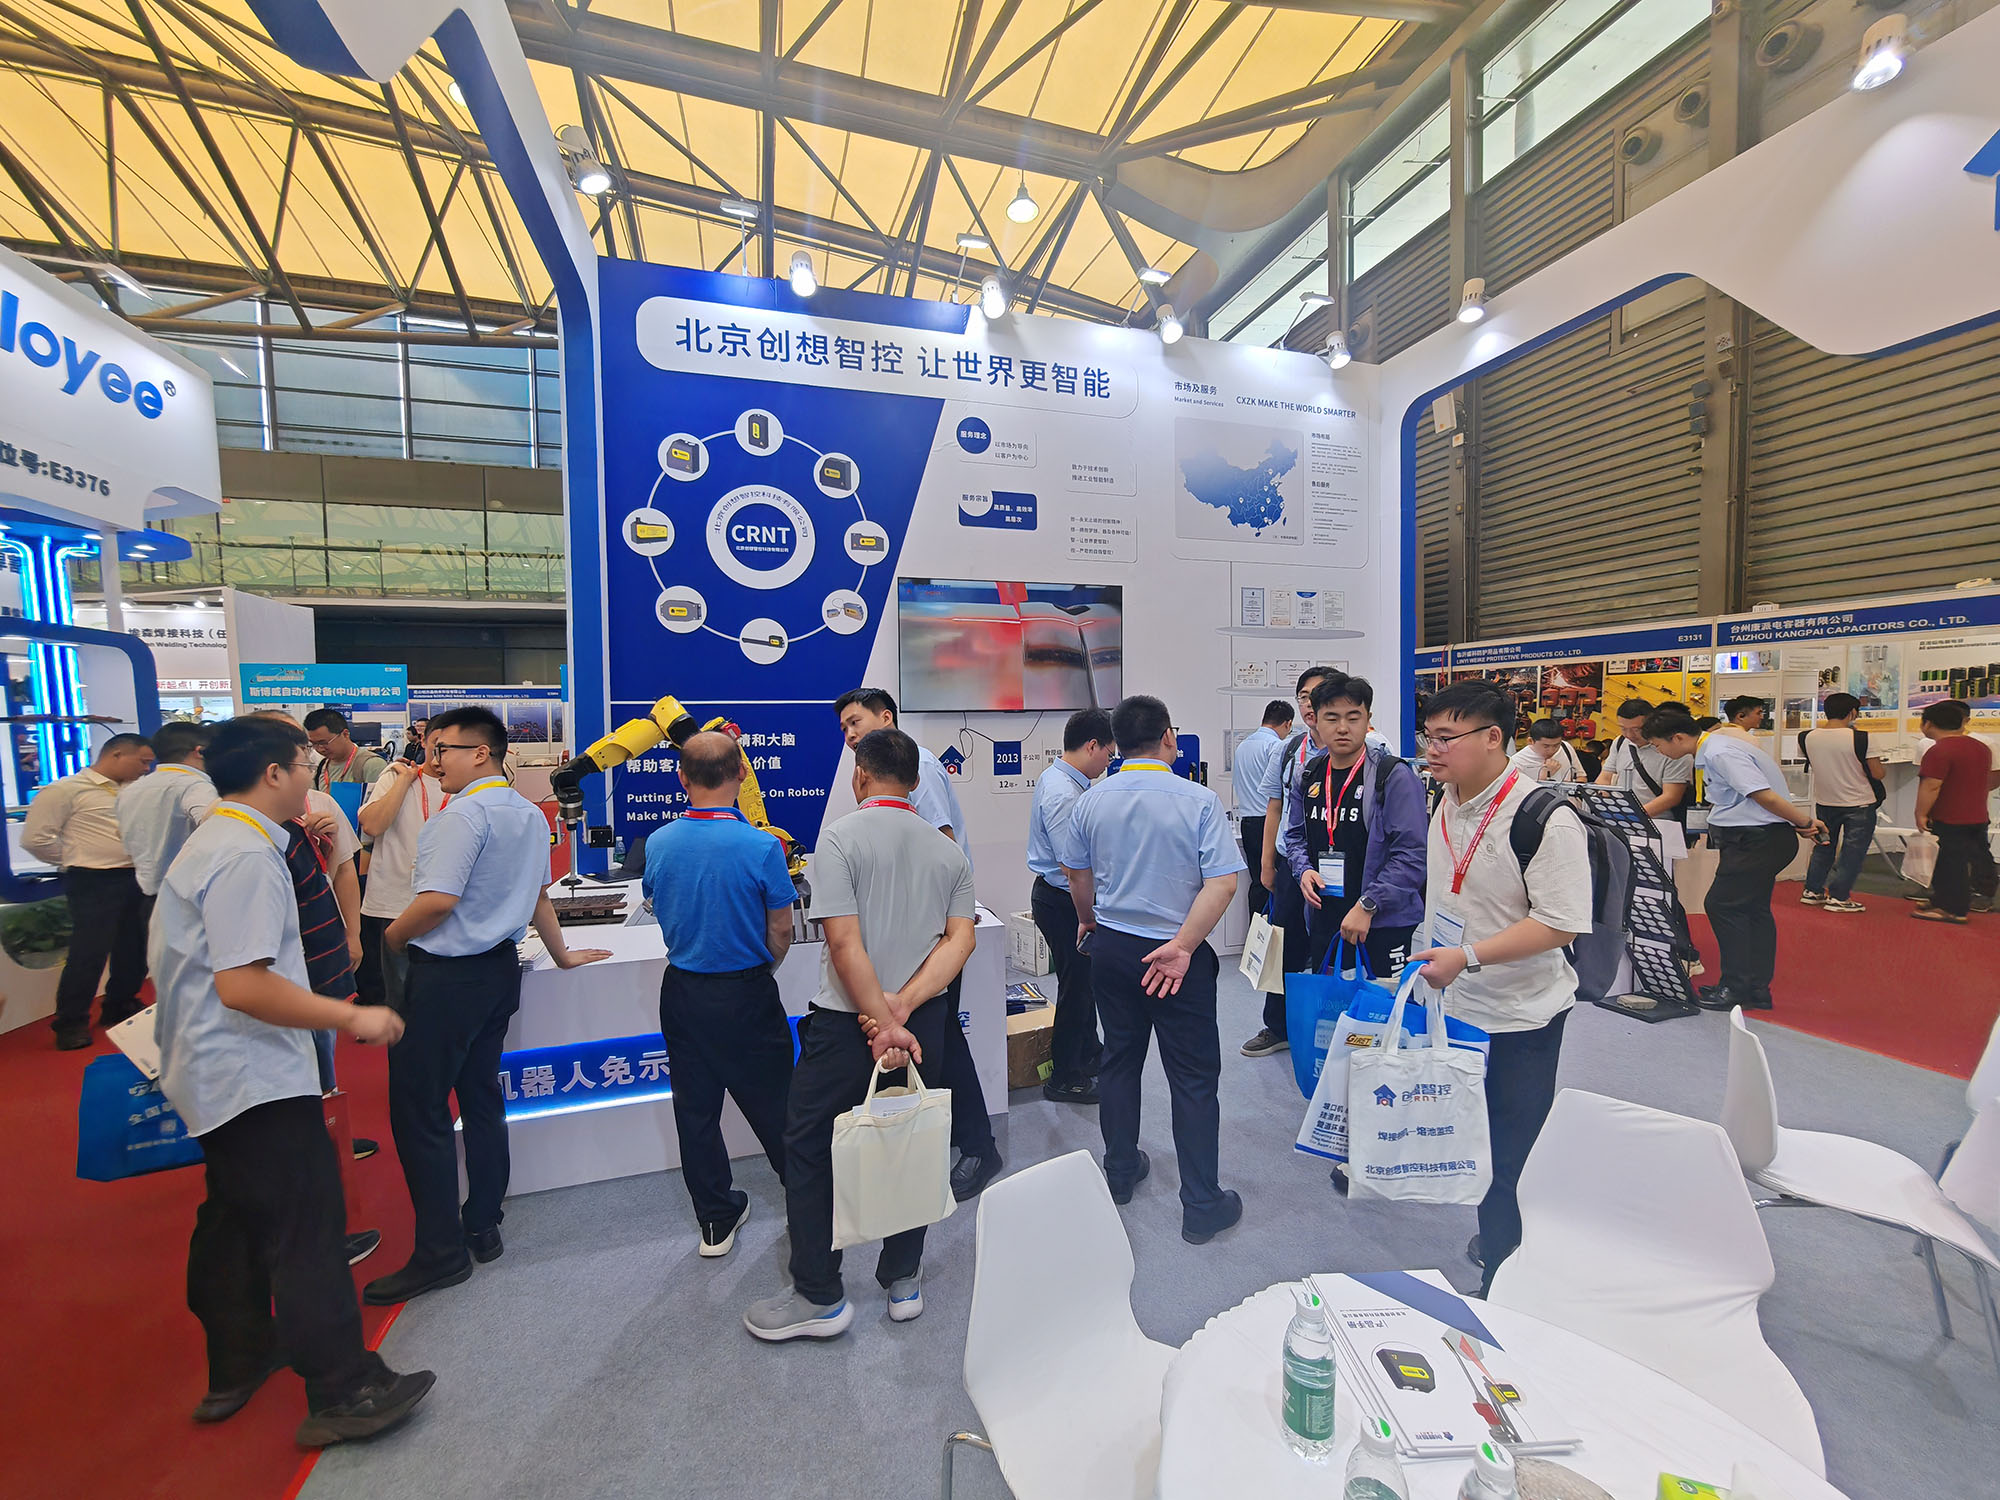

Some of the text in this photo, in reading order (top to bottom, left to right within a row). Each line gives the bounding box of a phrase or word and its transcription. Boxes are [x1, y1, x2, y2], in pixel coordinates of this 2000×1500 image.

[675, 317, 1110, 399] 北京创想智控 让世界更智能
[1174, 381, 1217, 396] 市场及服务
[1174, 396, 1193, 405] Market
[1203, 400, 1224, 408] Services
[1236, 396, 1357, 419] CXZK MAKE THE WORLD SMARTER
[731, 524, 791, 544] CRNT
[1730, 613, 1854, 634] 台州康派电容器有限公司
[1678, 634, 1703, 642] E3131
[1730, 632, 1773, 642] TAIZHOU
[1775, 627, 1824, 639] KANGPAI
[1826, 621, 1905, 635] CAPACITORS
[156, 641, 188, 649] Welding
[1486, 654, 1520, 662] PROTECTIVE
[1520, 651, 1554, 660] PRODUCTS
[626, 758, 681, 774] 帮助客
[996, 753, 1019, 764] 2013
[627, 793, 673, 805] Putting
[769, 788, 785, 799] On
[788, 786, 825, 798] Robots
[626, 811, 658, 822] Make
